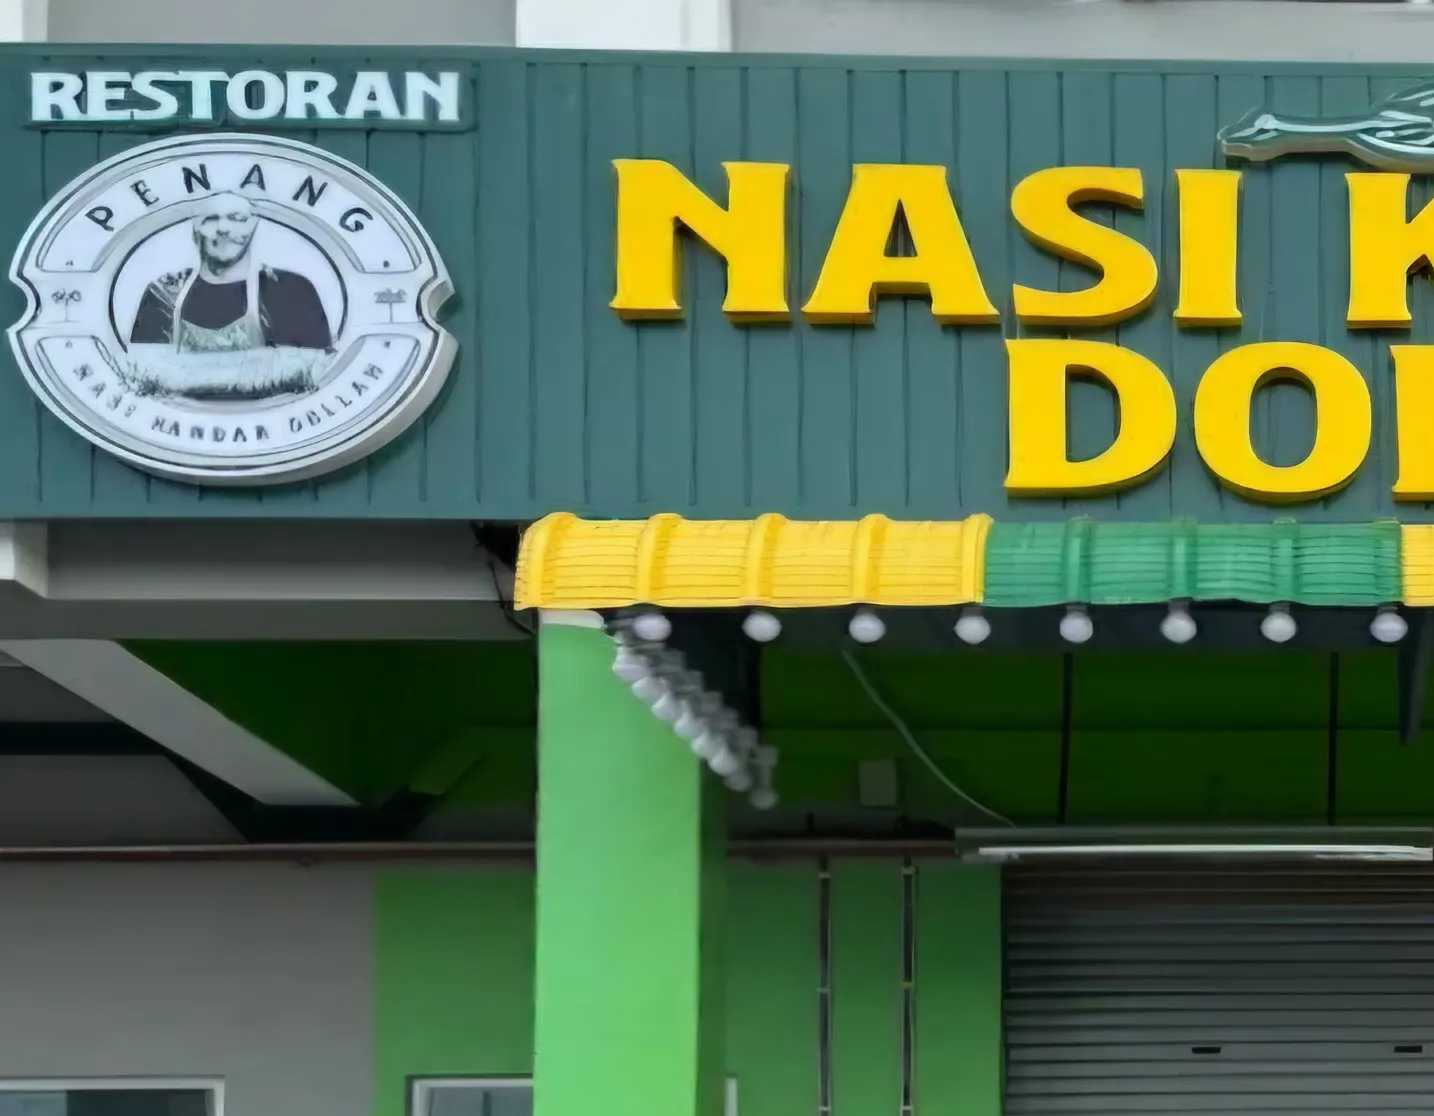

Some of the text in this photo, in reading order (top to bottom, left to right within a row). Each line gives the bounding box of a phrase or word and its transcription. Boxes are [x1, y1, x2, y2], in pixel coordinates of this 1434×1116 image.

[30, 70, 461, 122] RESTORAN
[85, 162, 375, 233] PENANG
[611, 158, 1243, 327] NASI
